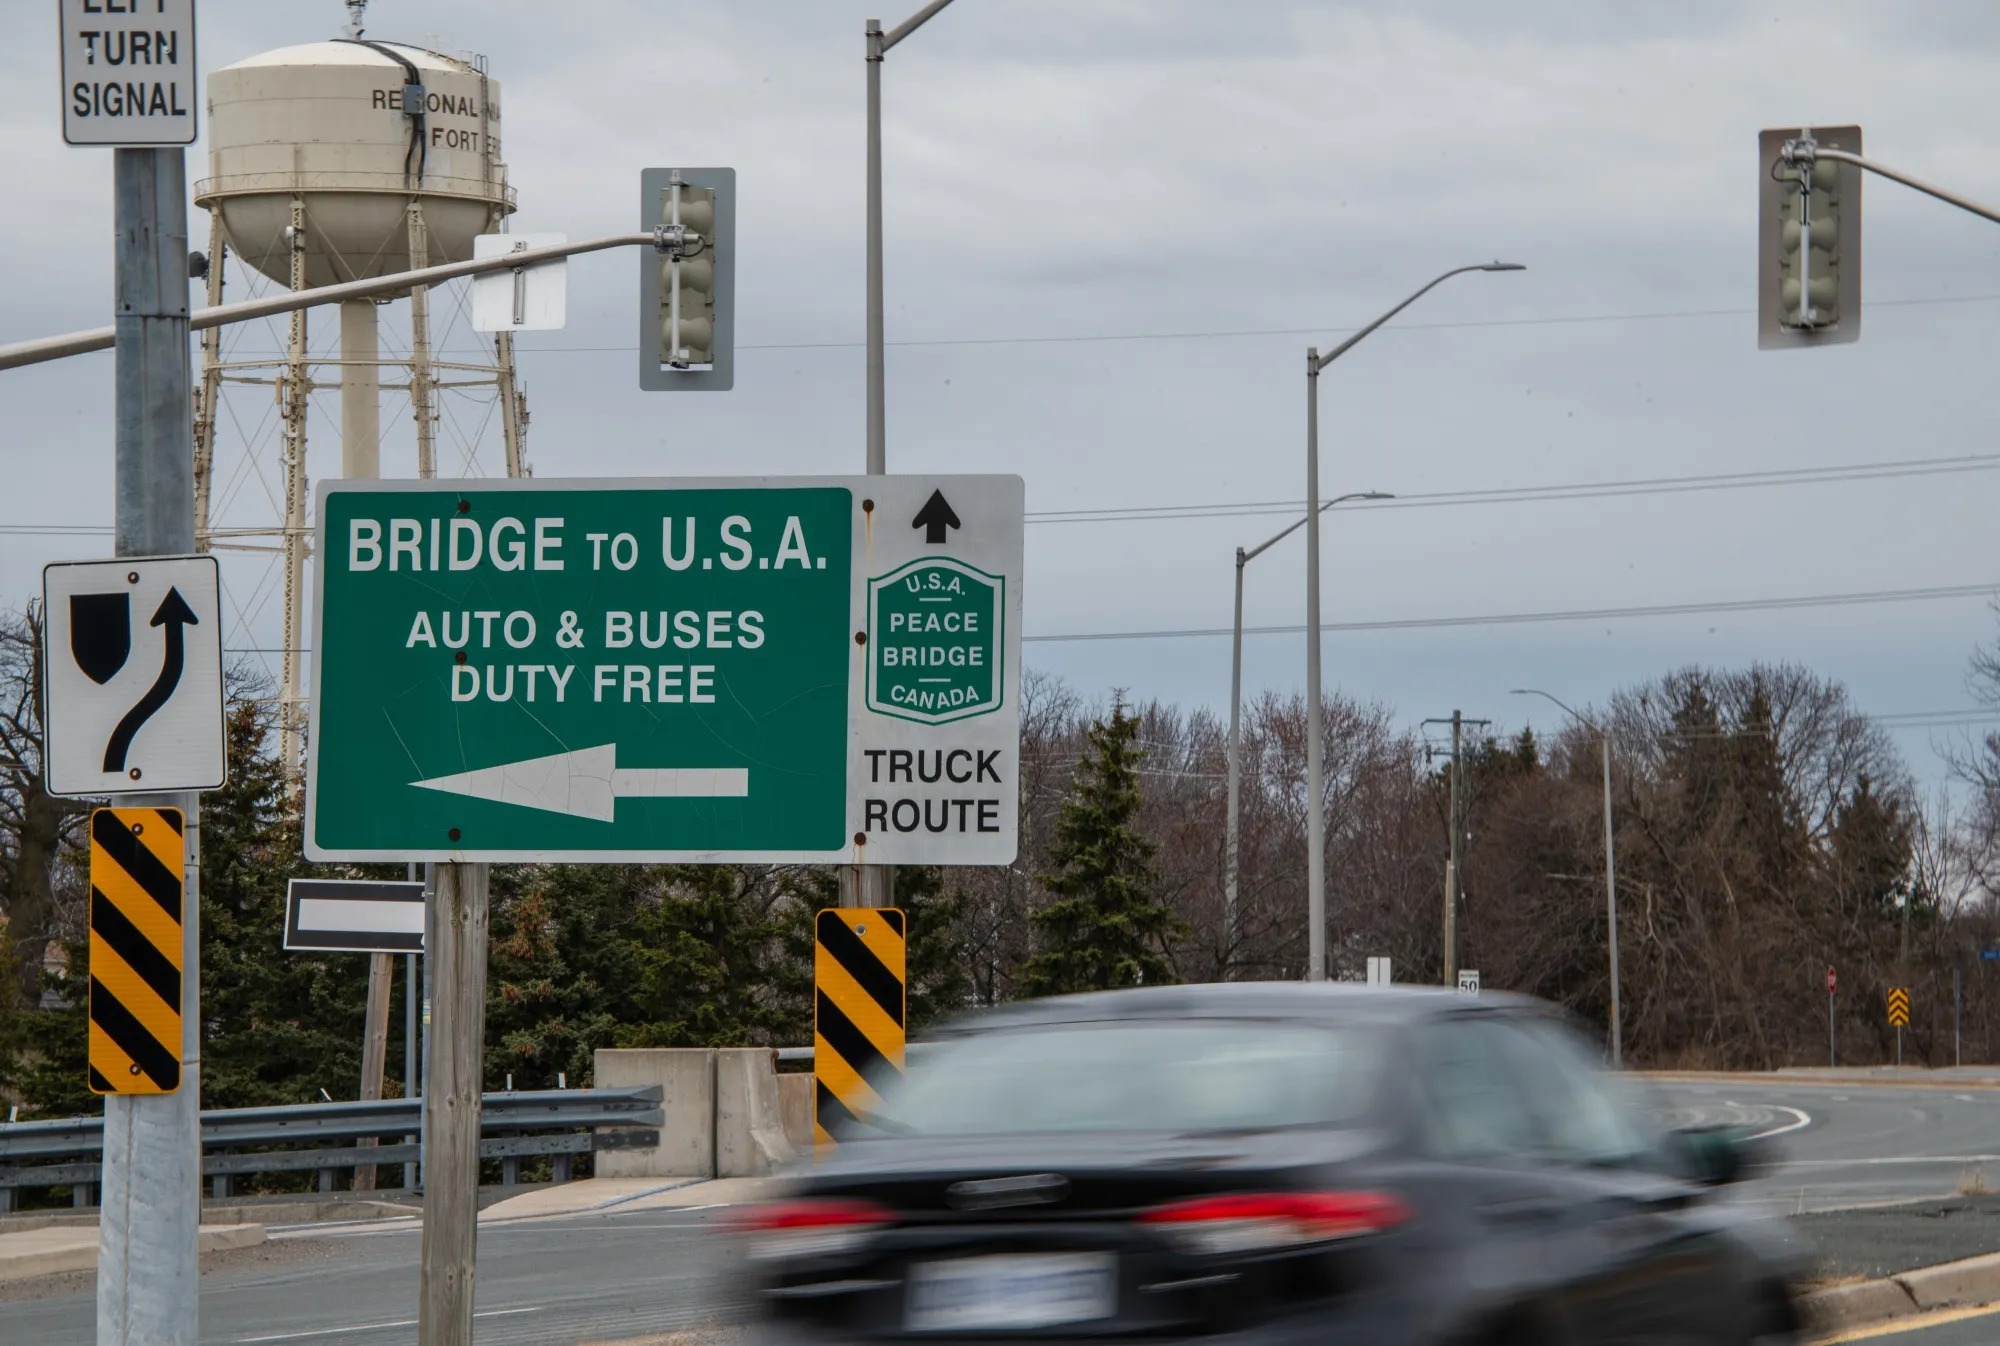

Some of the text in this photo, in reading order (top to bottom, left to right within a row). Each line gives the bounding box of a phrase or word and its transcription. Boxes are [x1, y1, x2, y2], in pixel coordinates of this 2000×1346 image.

[79, 31, 177, 66] TURN
[73, 82, 187, 117] SIGNAL
[372, 89, 478, 117] REONAL
[431, 127, 479, 151] FORT
[348, 517, 565, 572] BRIDGE
[662, 515, 827, 571] U.S.A.
[905, 572, 966, 596] U.S.A.
[406, 610, 765, 649] AUTO & BUSES
[890, 612, 979, 632] PEACE
[883, 646, 983, 667] BRIDGE
[451, 664, 716, 703] DUTY FREE
[890, 685, 980, 709] CANADA
[864, 750, 1002, 783] TRUCK
[864, 799, 1000, 833] ROUTE
[1461, 980, 1477, 994] 50
